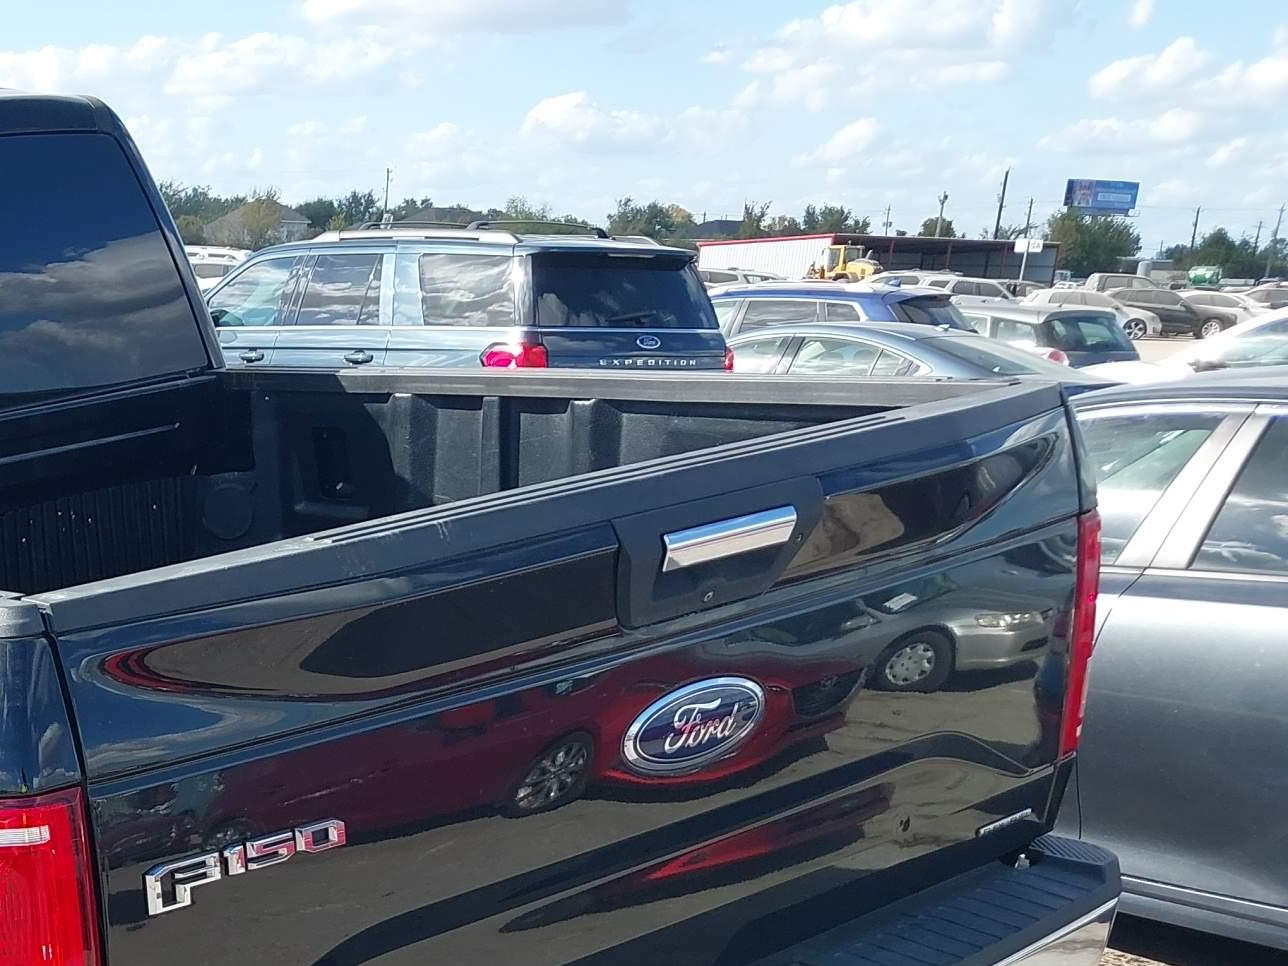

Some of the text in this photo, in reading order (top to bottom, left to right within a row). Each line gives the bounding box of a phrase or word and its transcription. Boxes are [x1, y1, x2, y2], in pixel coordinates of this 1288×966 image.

[599, 358, 697, 367] EXPEDITION
[663, 697, 739, 754] Ford
[143, 817, 348, 917] F150
